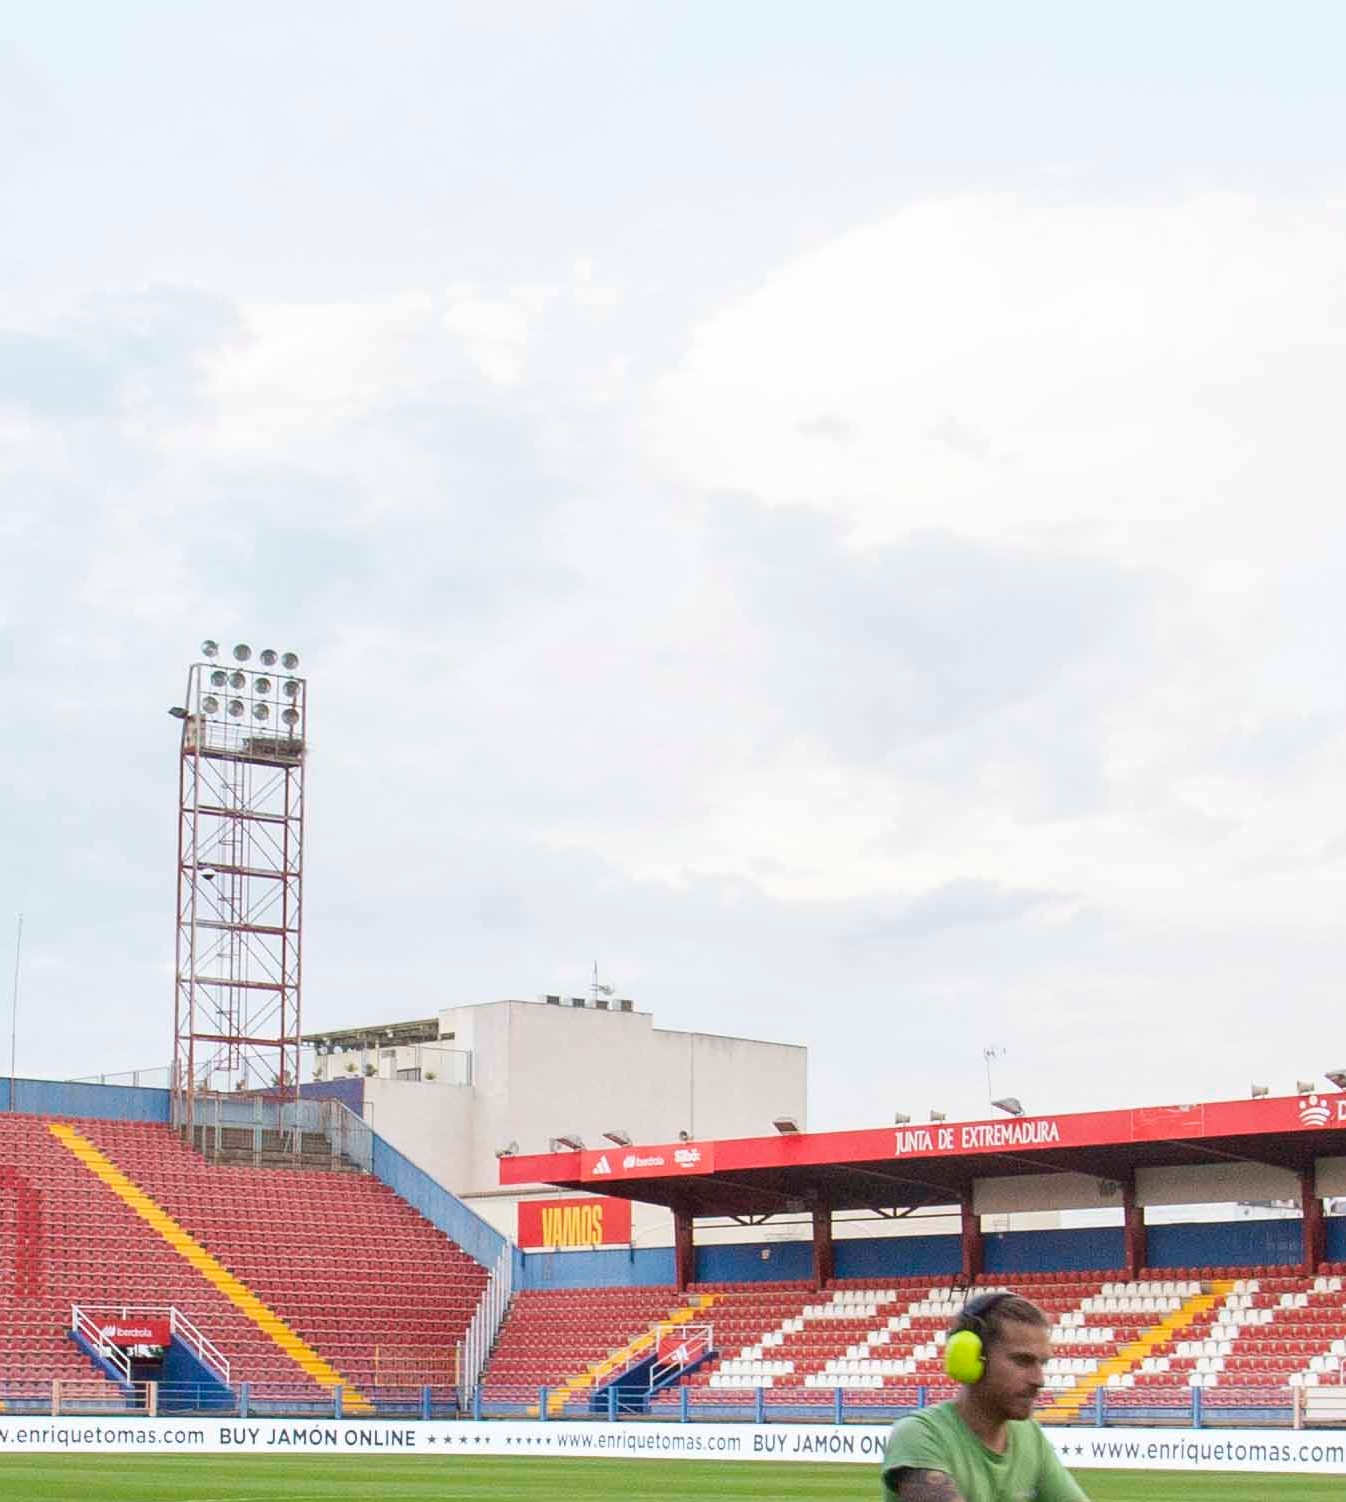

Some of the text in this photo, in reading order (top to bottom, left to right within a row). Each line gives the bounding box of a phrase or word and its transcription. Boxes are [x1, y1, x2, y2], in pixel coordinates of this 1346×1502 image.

[895, 1121, 1060, 1156] JUNTA DE EXTREMADURA
[541, 1204, 604, 1249] VAMOS
[220, 1424, 416, 1448] BUY JAMÓN ONLINE
[557, 1431, 741, 1453] www.enriquetomas.com
[753, 1434, 787, 1452] BUY
[792, 1429, 855, 1453] JAMÓN
[1092, 1438, 1344, 1465] www.enriquetomas.com
